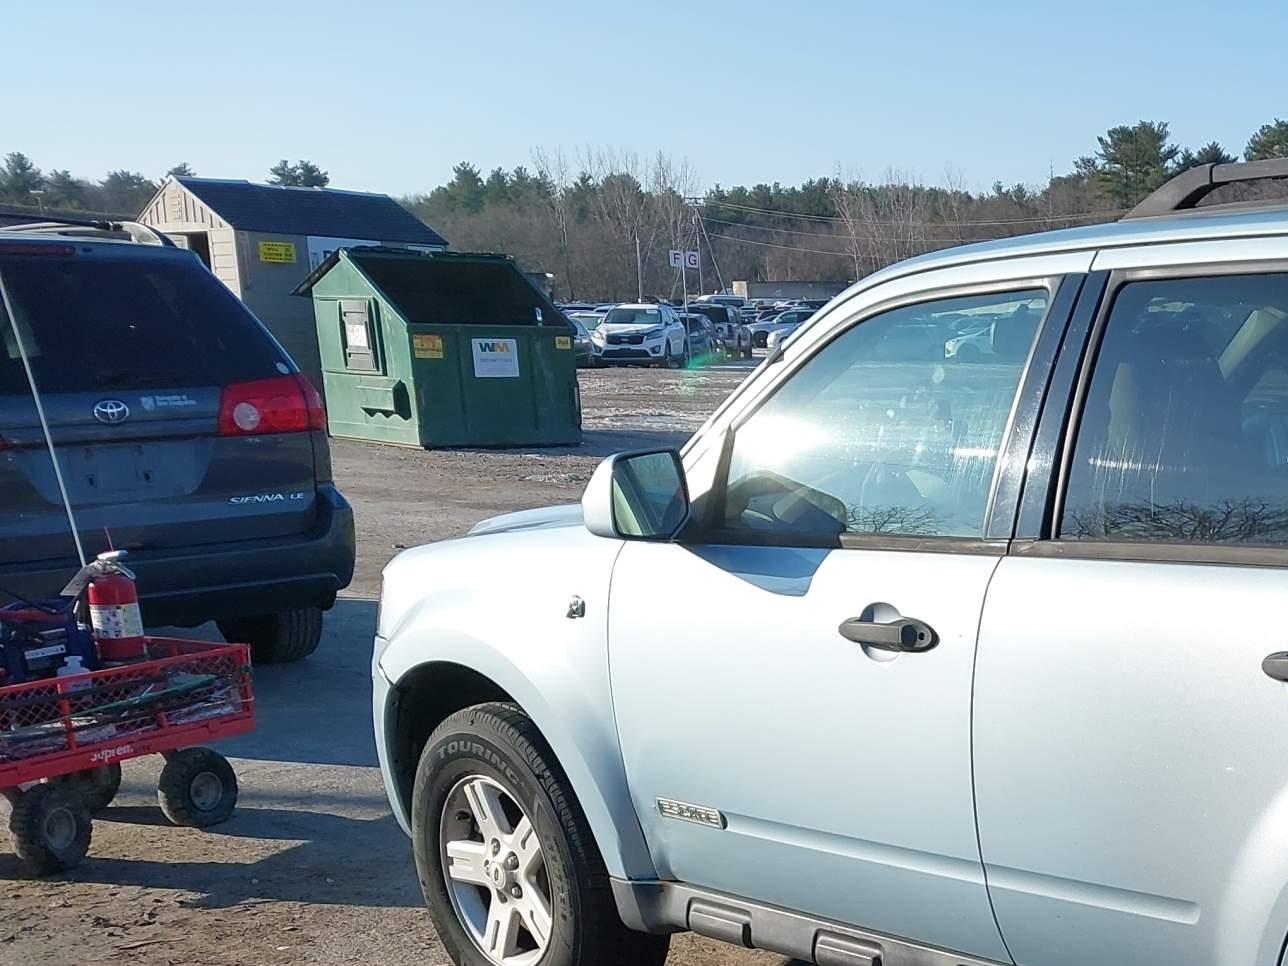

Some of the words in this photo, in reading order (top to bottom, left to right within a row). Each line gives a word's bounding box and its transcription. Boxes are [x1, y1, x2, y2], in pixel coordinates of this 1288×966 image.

[673, 252, 681, 264] F
[688, 253, 697, 266] G
[479, 342, 510, 353] WM
[228, 493, 284, 504] SIENNA
[290, 492, 304, 500] LE
[437, 740, 520, 785] TOURING
